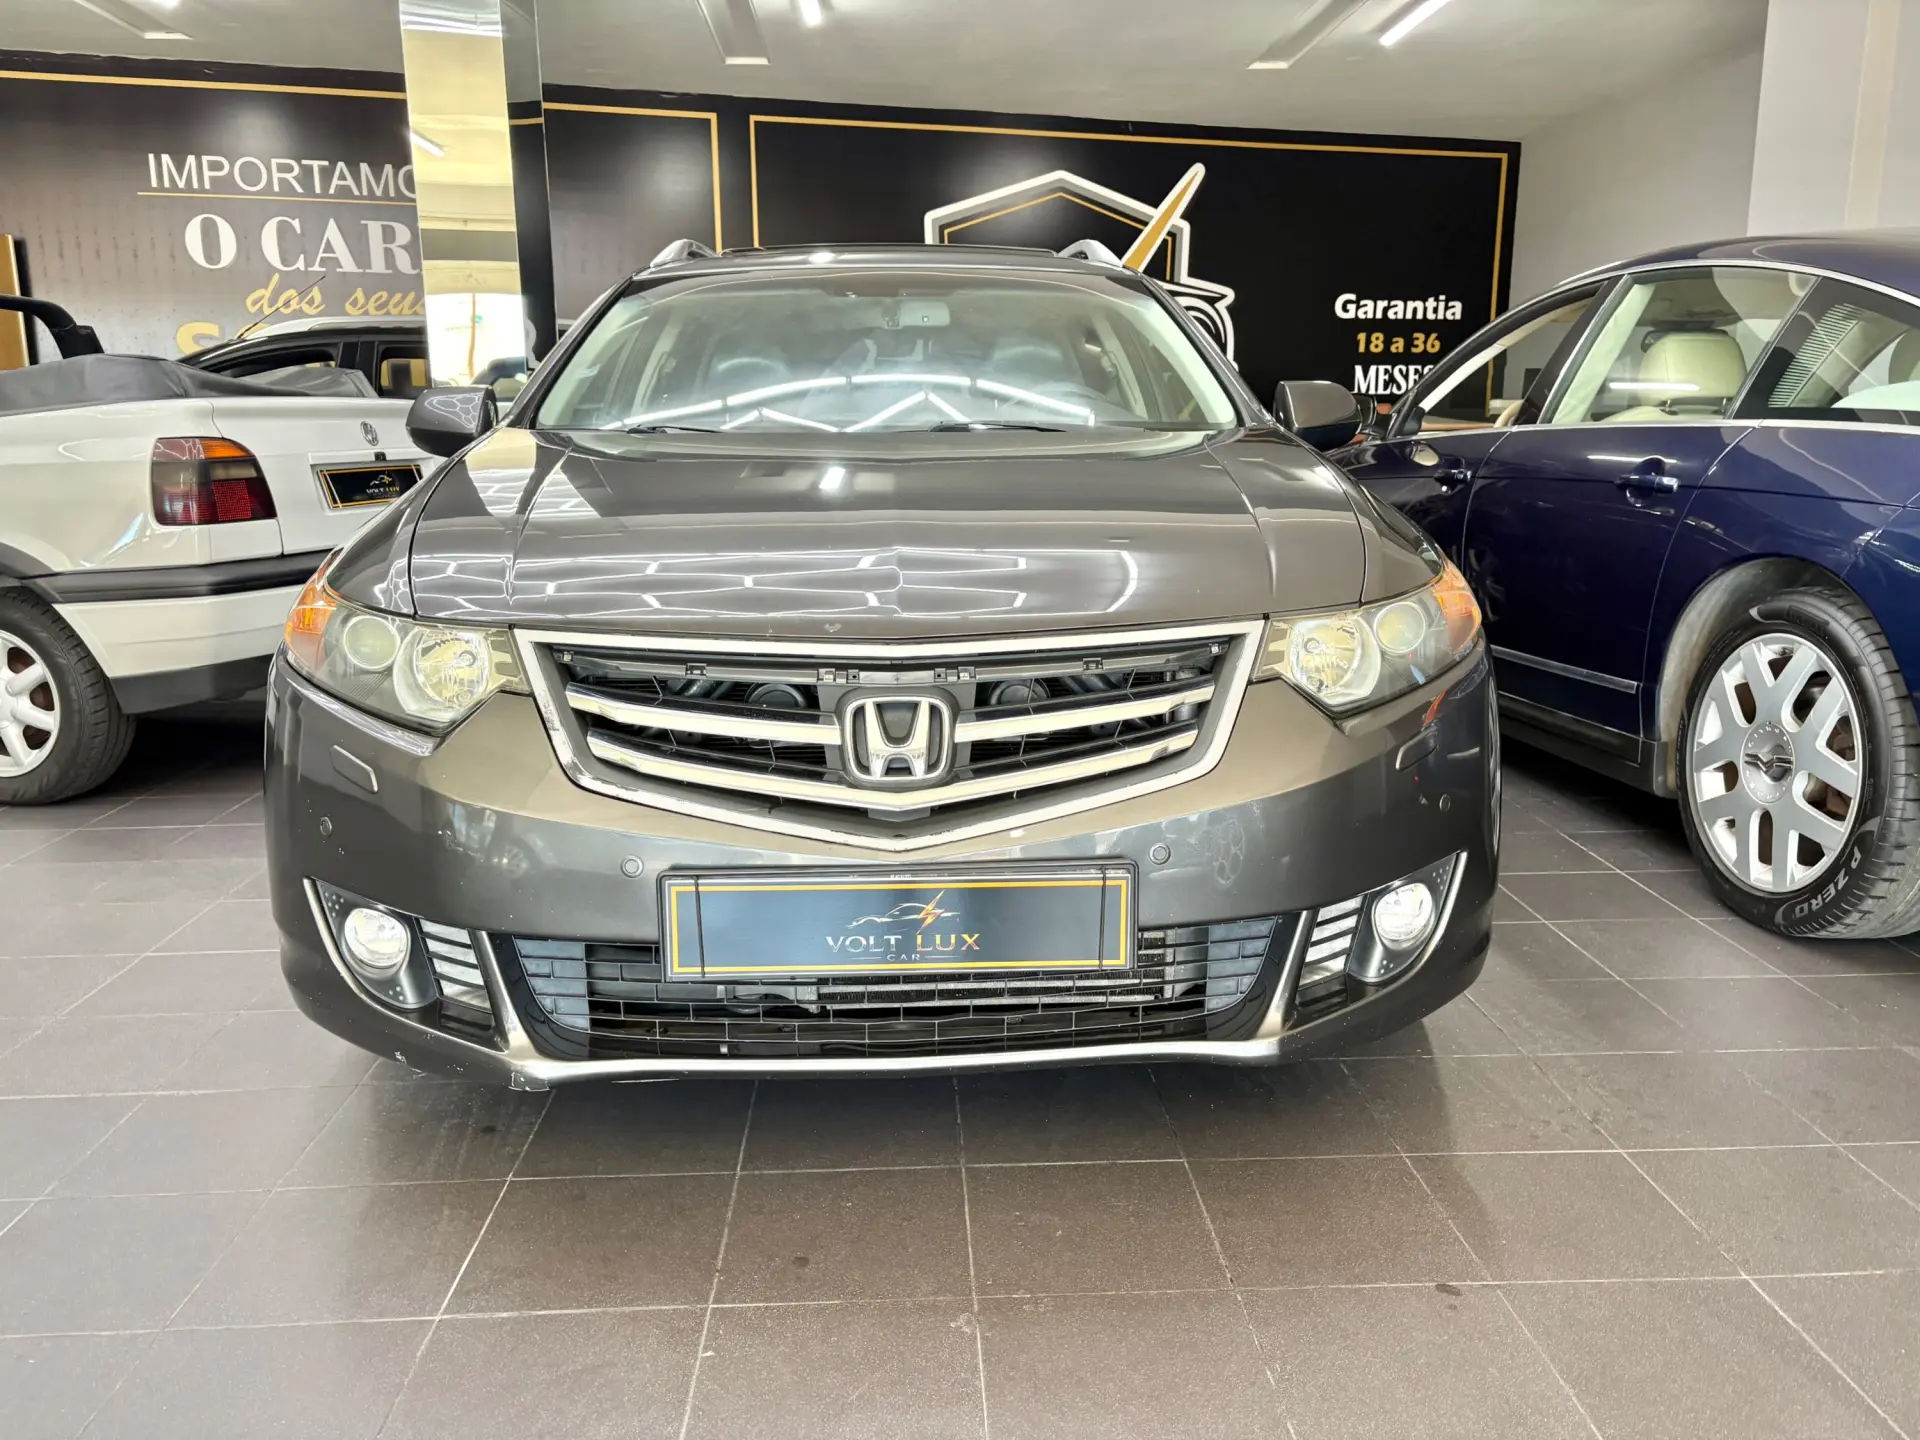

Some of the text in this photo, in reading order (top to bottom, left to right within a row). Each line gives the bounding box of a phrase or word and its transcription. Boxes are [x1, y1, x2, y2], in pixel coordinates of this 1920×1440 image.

[184, 213, 237, 270] O
[245, 272, 326, 316] dos
[1334, 292, 1463, 321] Garantia
[1356, 332, 1441, 354] 18 a 36
[1794, 867, 1849, 919] ZERO
[825, 933, 981, 953] VOLT LUX
[886, 953, 921, 962] CAR
